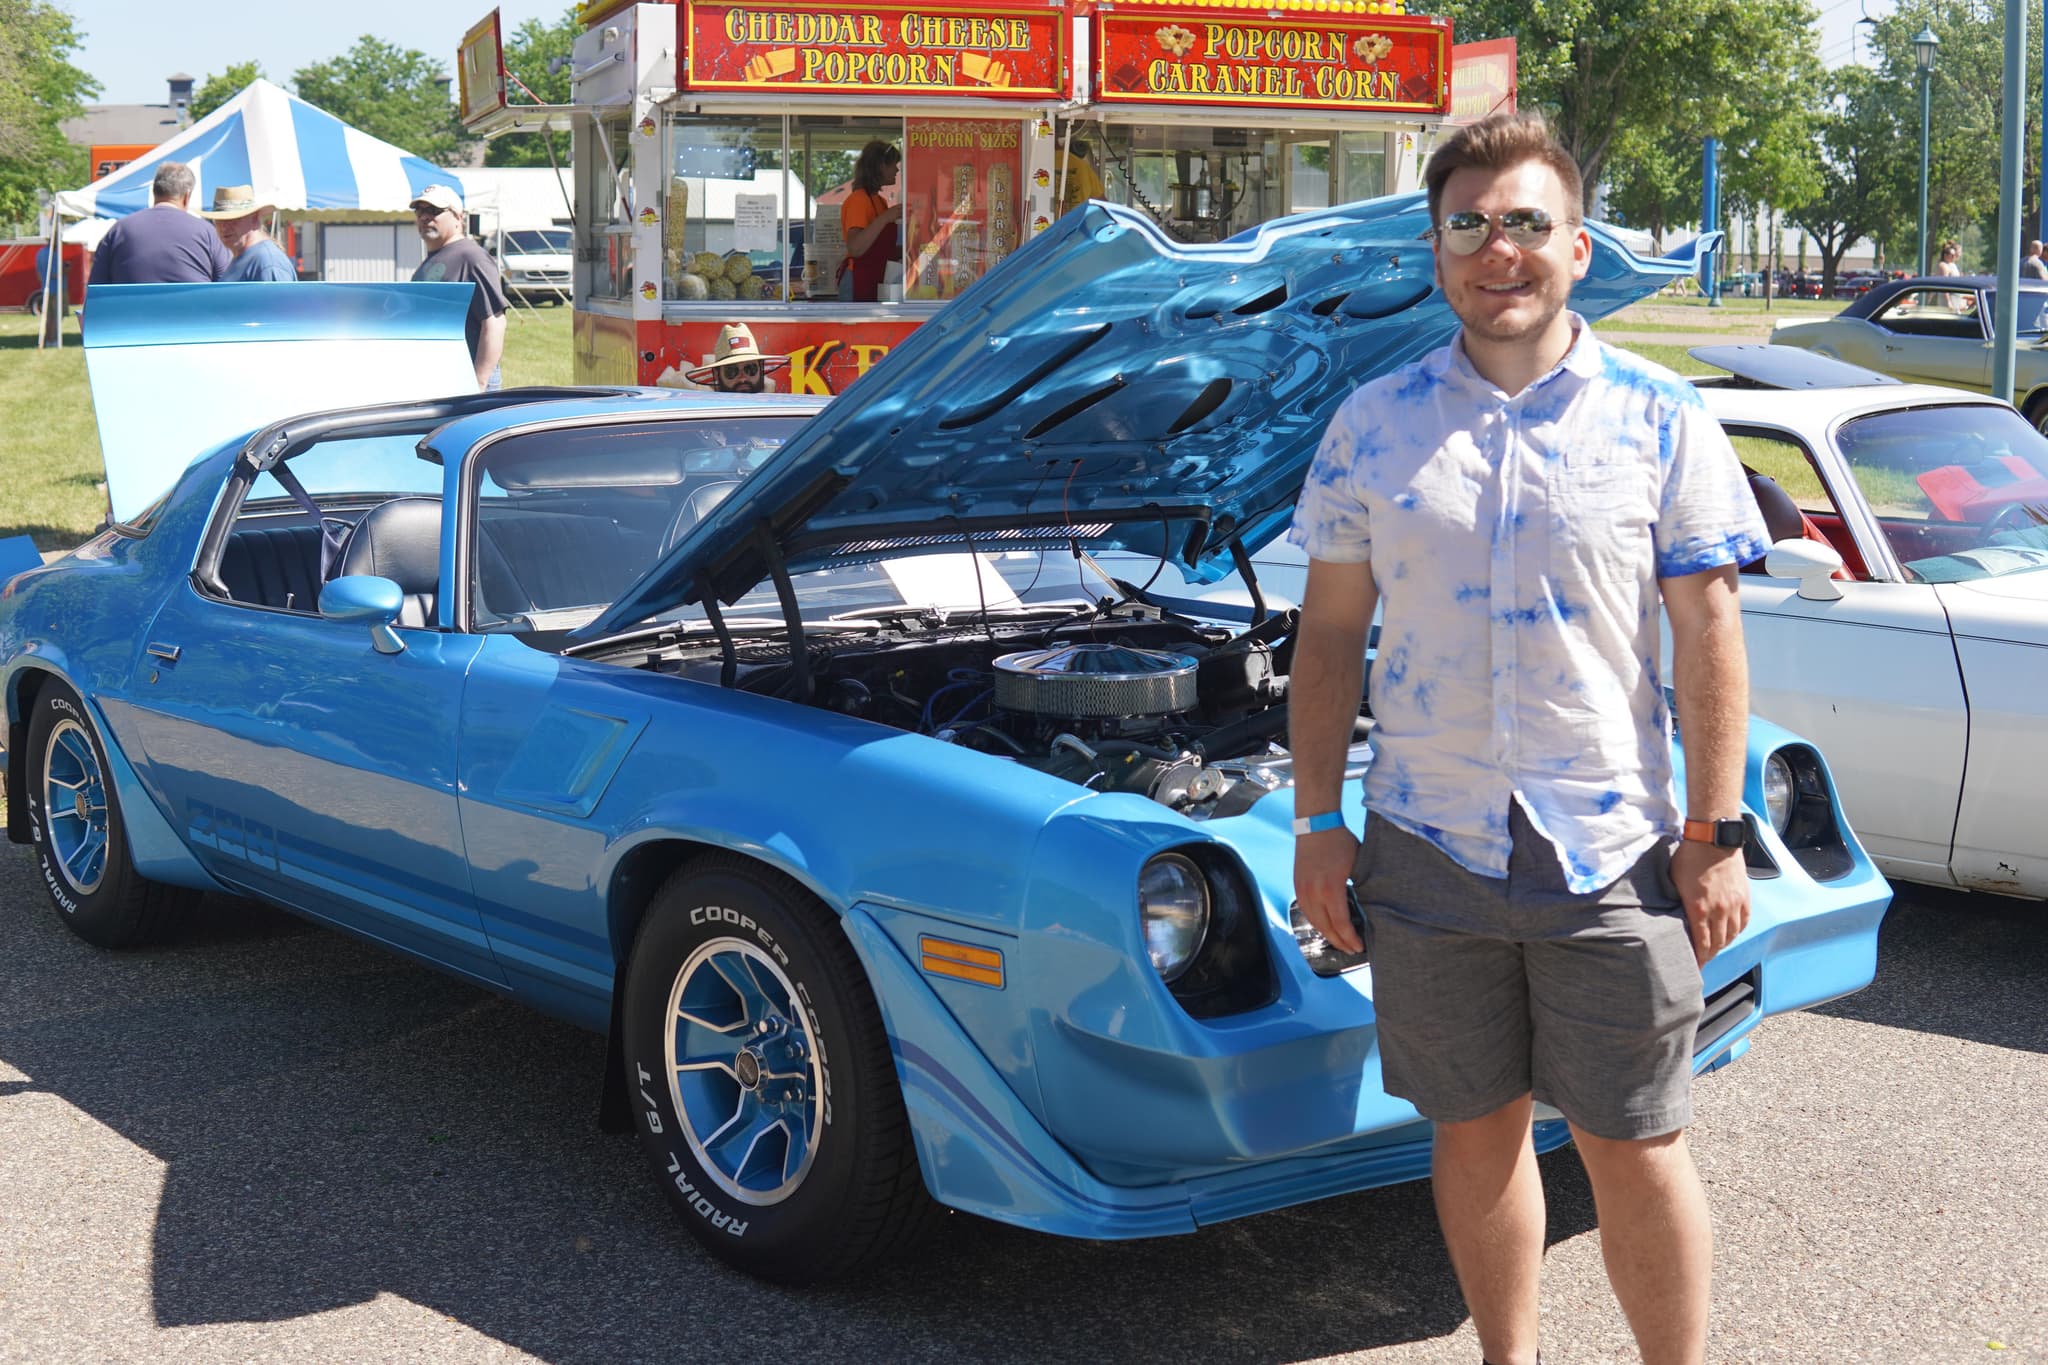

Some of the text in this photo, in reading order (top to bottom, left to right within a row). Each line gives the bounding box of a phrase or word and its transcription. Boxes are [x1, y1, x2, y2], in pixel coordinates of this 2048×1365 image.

[725, 8, 1029, 49] CHEDDAR CHEESE
[1204, 23, 1347, 63] POPCORN
[801, 48, 954, 86] POPCORN
[1148, 58, 1398, 101] CARAMEL CORN
[910, 131, 1017, 149] POPCORN SIZES
[996, 182, 1004, 265] LARGE
[42, 854, 77, 914] RADIAL
[690, 906, 832, 1125] COOPER COBRA
[637, 1062, 749, 1237] RADIAL G/T
